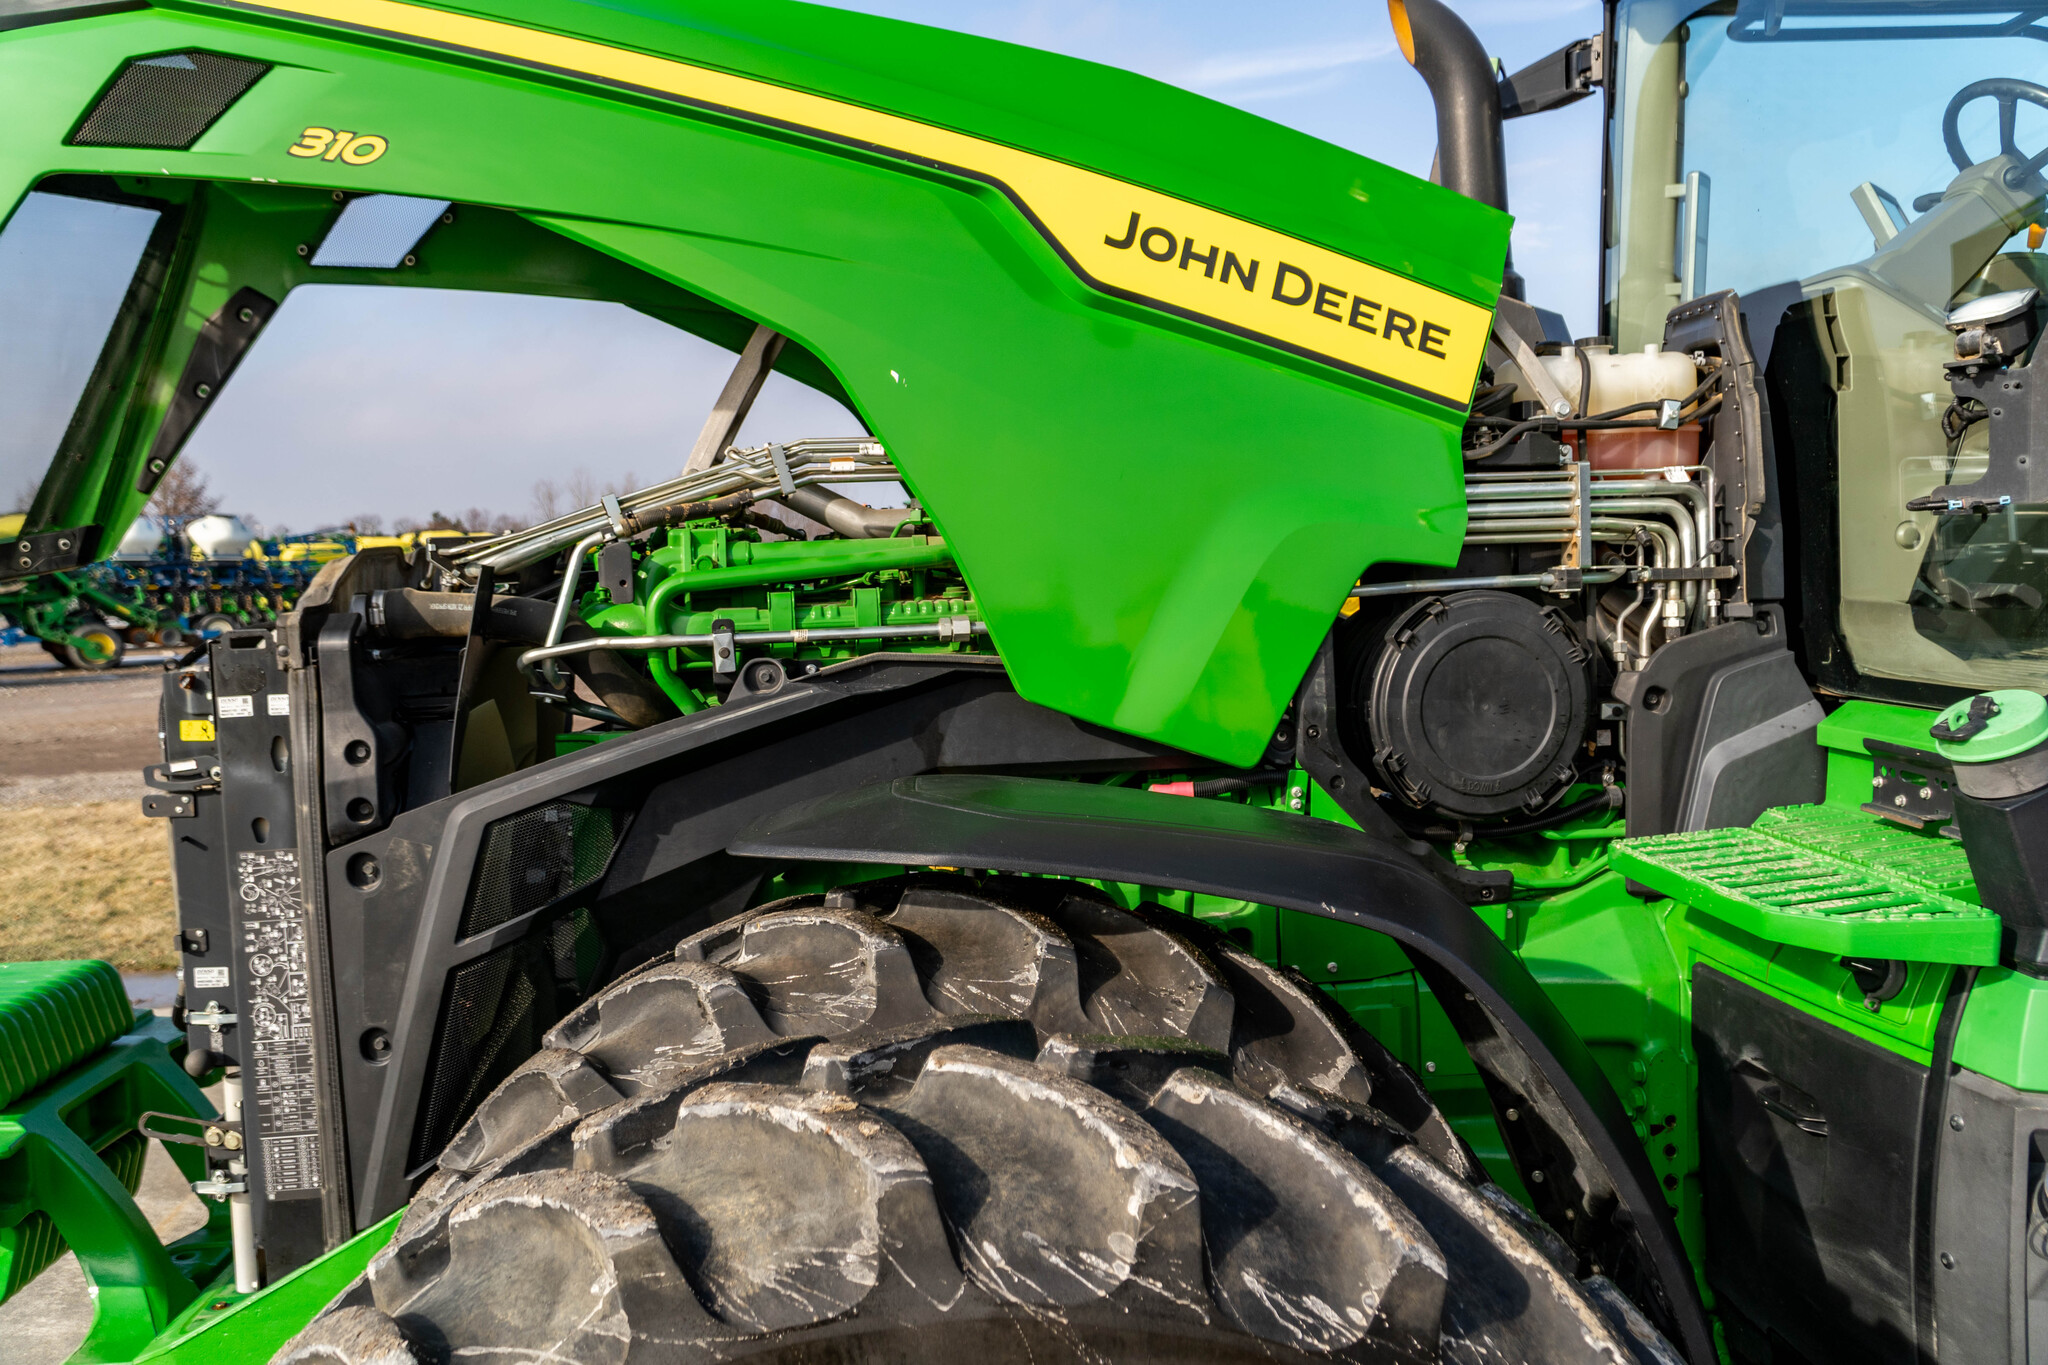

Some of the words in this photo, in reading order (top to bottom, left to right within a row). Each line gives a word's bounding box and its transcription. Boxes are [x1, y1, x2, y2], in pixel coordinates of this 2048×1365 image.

[287, 126, 389, 166] 310
[1103, 211, 1260, 292] JOHN
[1271, 261, 1451, 360] DEERE
